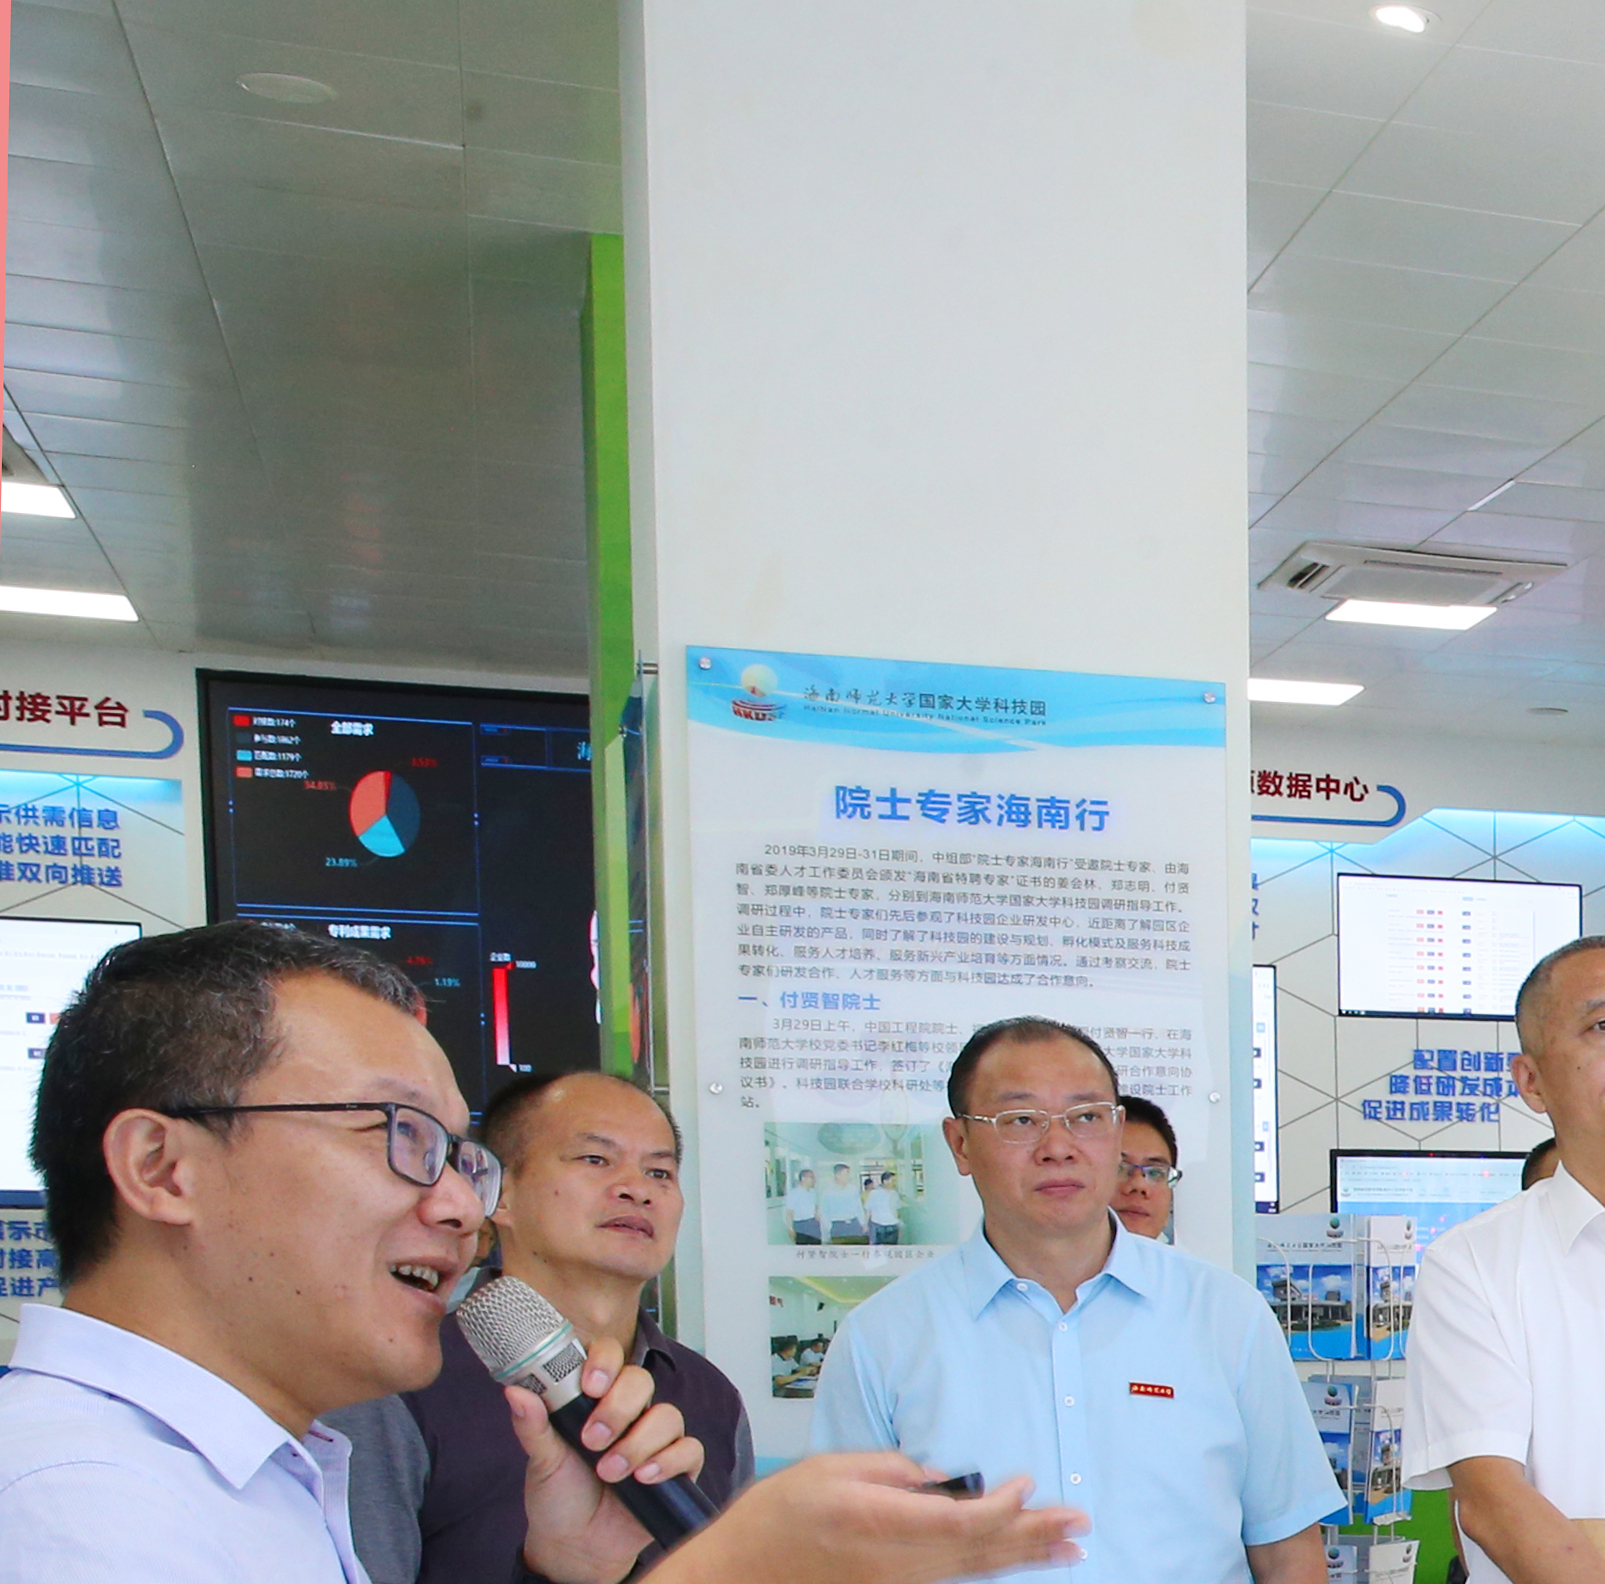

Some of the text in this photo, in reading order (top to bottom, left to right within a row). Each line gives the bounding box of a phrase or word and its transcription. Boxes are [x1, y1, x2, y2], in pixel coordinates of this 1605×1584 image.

[803, 684, 1047, 716] 海南师范大学国家大学科技园
[834, 785, 1110, 832] 院士专家海南行
[738, 991, 881, 1011] 一、付贤智院士
[1361, 1099, 1500, 1123] 促进成果转化
